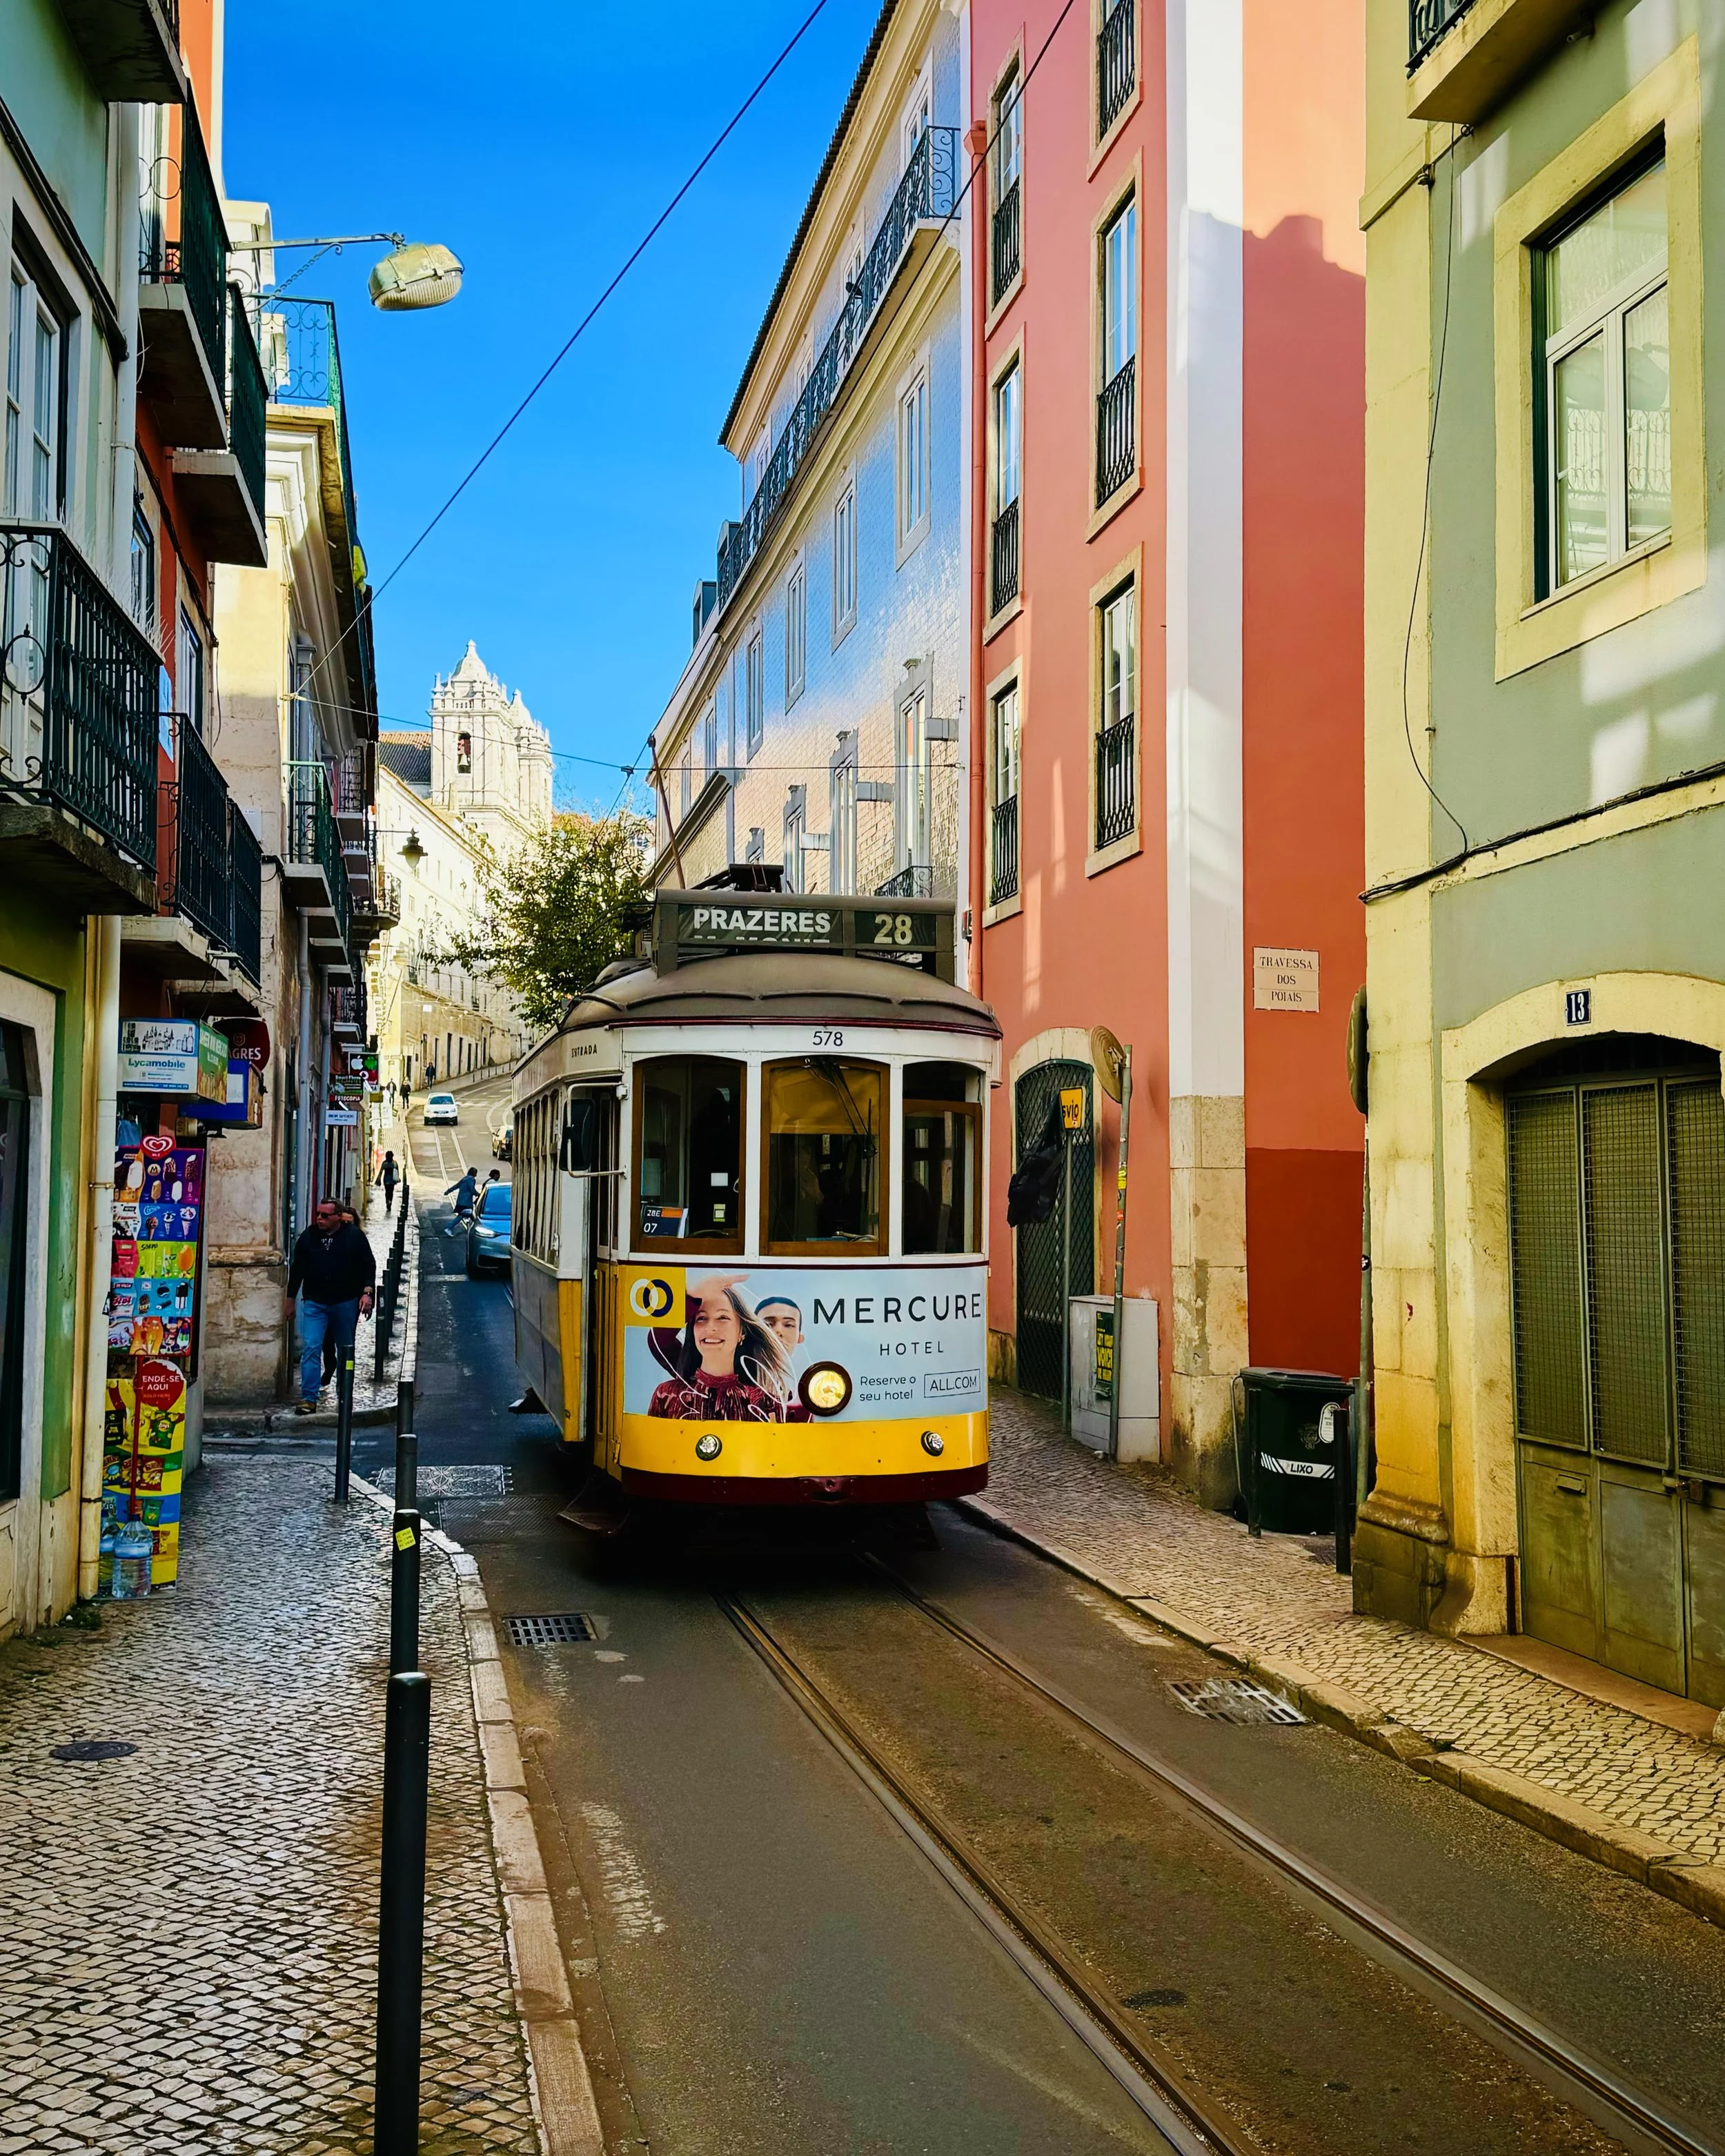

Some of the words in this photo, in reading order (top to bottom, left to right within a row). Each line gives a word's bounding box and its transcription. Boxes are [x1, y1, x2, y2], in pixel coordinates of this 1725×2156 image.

[693, 908, 831, 933] PRAZERES
[873, 913, 912, 945] 28
[1259, 956, 1312, 969] TRAVESSA
[1277, 974, 1296, 985] DOS
[1271, 991, 1302, 1002] POIAIS
[1570, 993, 1585, 1021] 13
[813, 1031, 843, 1047] 578
[571, 1044, 598, 1058] ENTRADA
[128, 1058, 186, 1069] Lycamobile
[644, 1223, 658, 1233] 07
[814, 1293, 981, 1325] MERCURE
[880, 1341, 944, 1356] HOTEL
[860, 1376, 906, 1385] Reserve
[929, 1375, 977, 1392] ALL.COM
[859, 1392, 880, 1401] seu
[885, 1389, 913, 1400] hotel
[1290, 1463, 1313, 1474] LIXO
